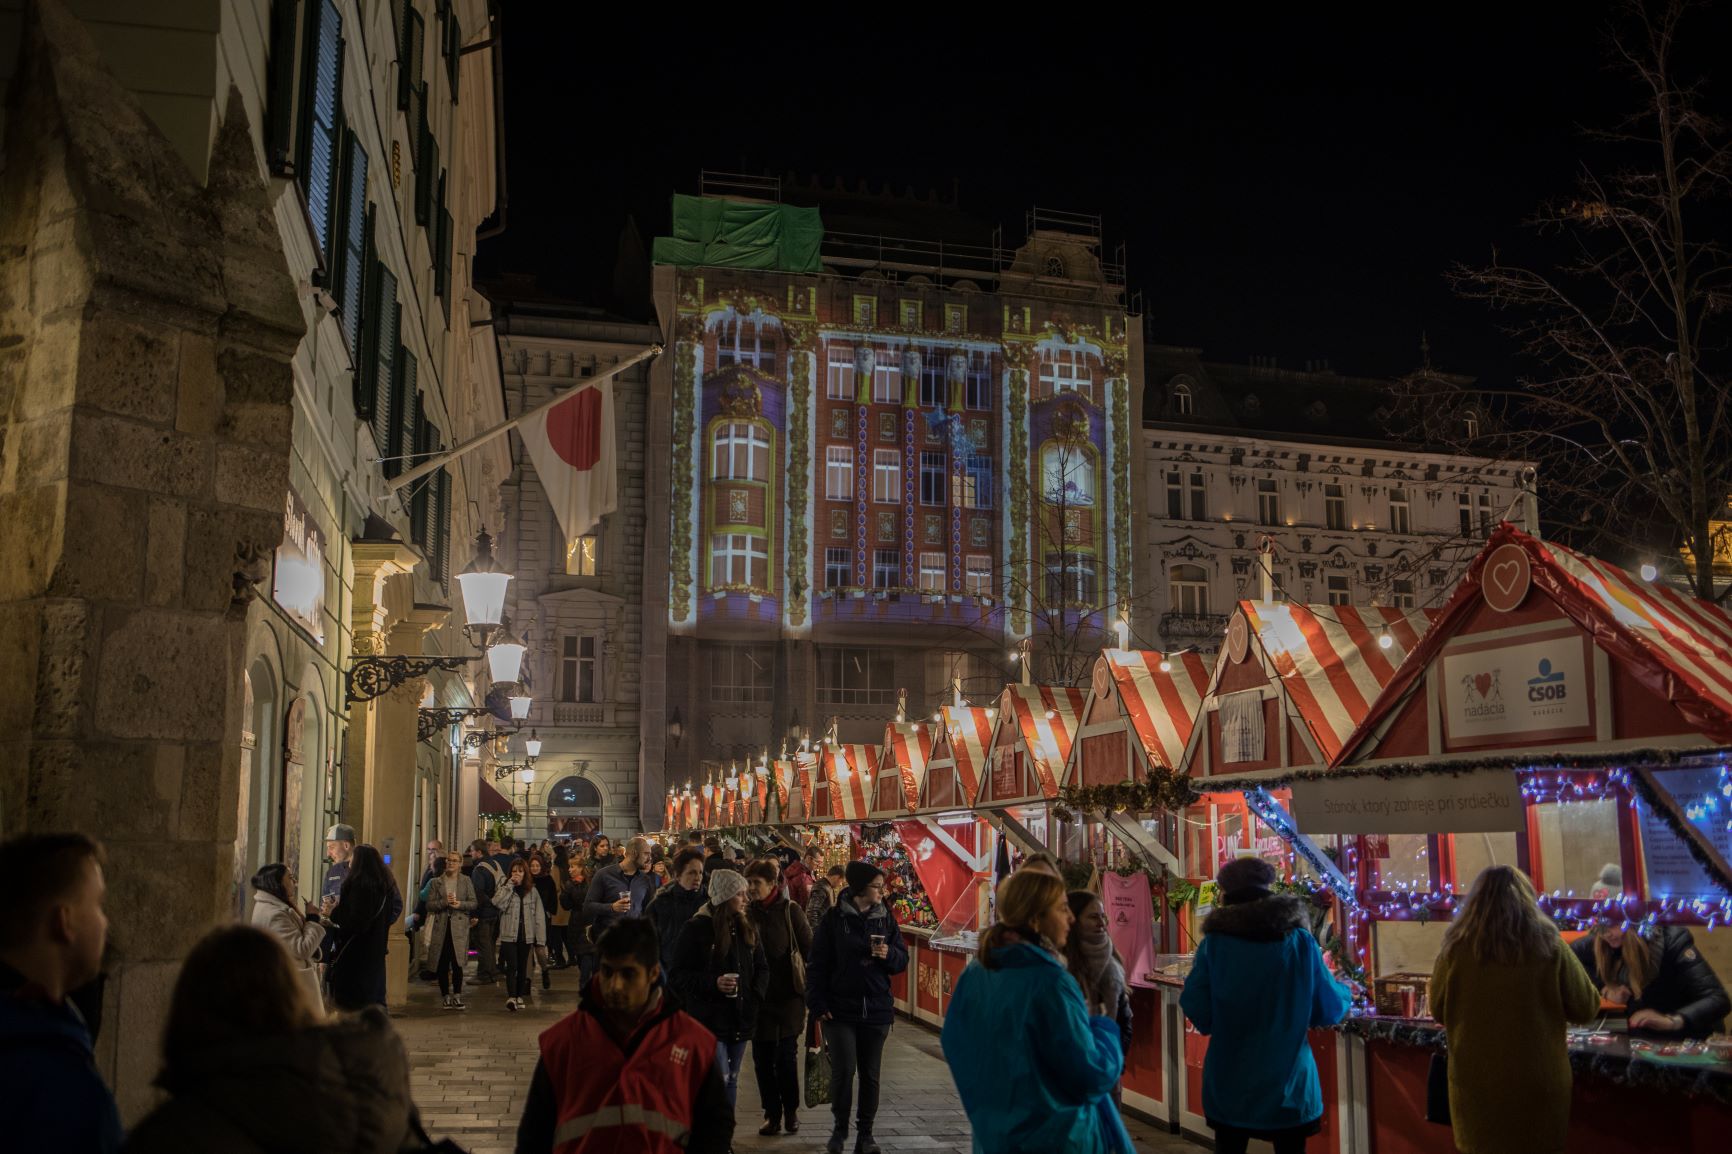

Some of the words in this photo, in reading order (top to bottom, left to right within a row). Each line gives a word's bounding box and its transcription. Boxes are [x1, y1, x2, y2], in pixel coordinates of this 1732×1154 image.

[1528, 684, 1567, 703] ČSOB
[1464, 702, 1505, 717] nadácia
[1438, 794, 1456, 815] pri
[1458, 791, 1510, 810] srdiečku
